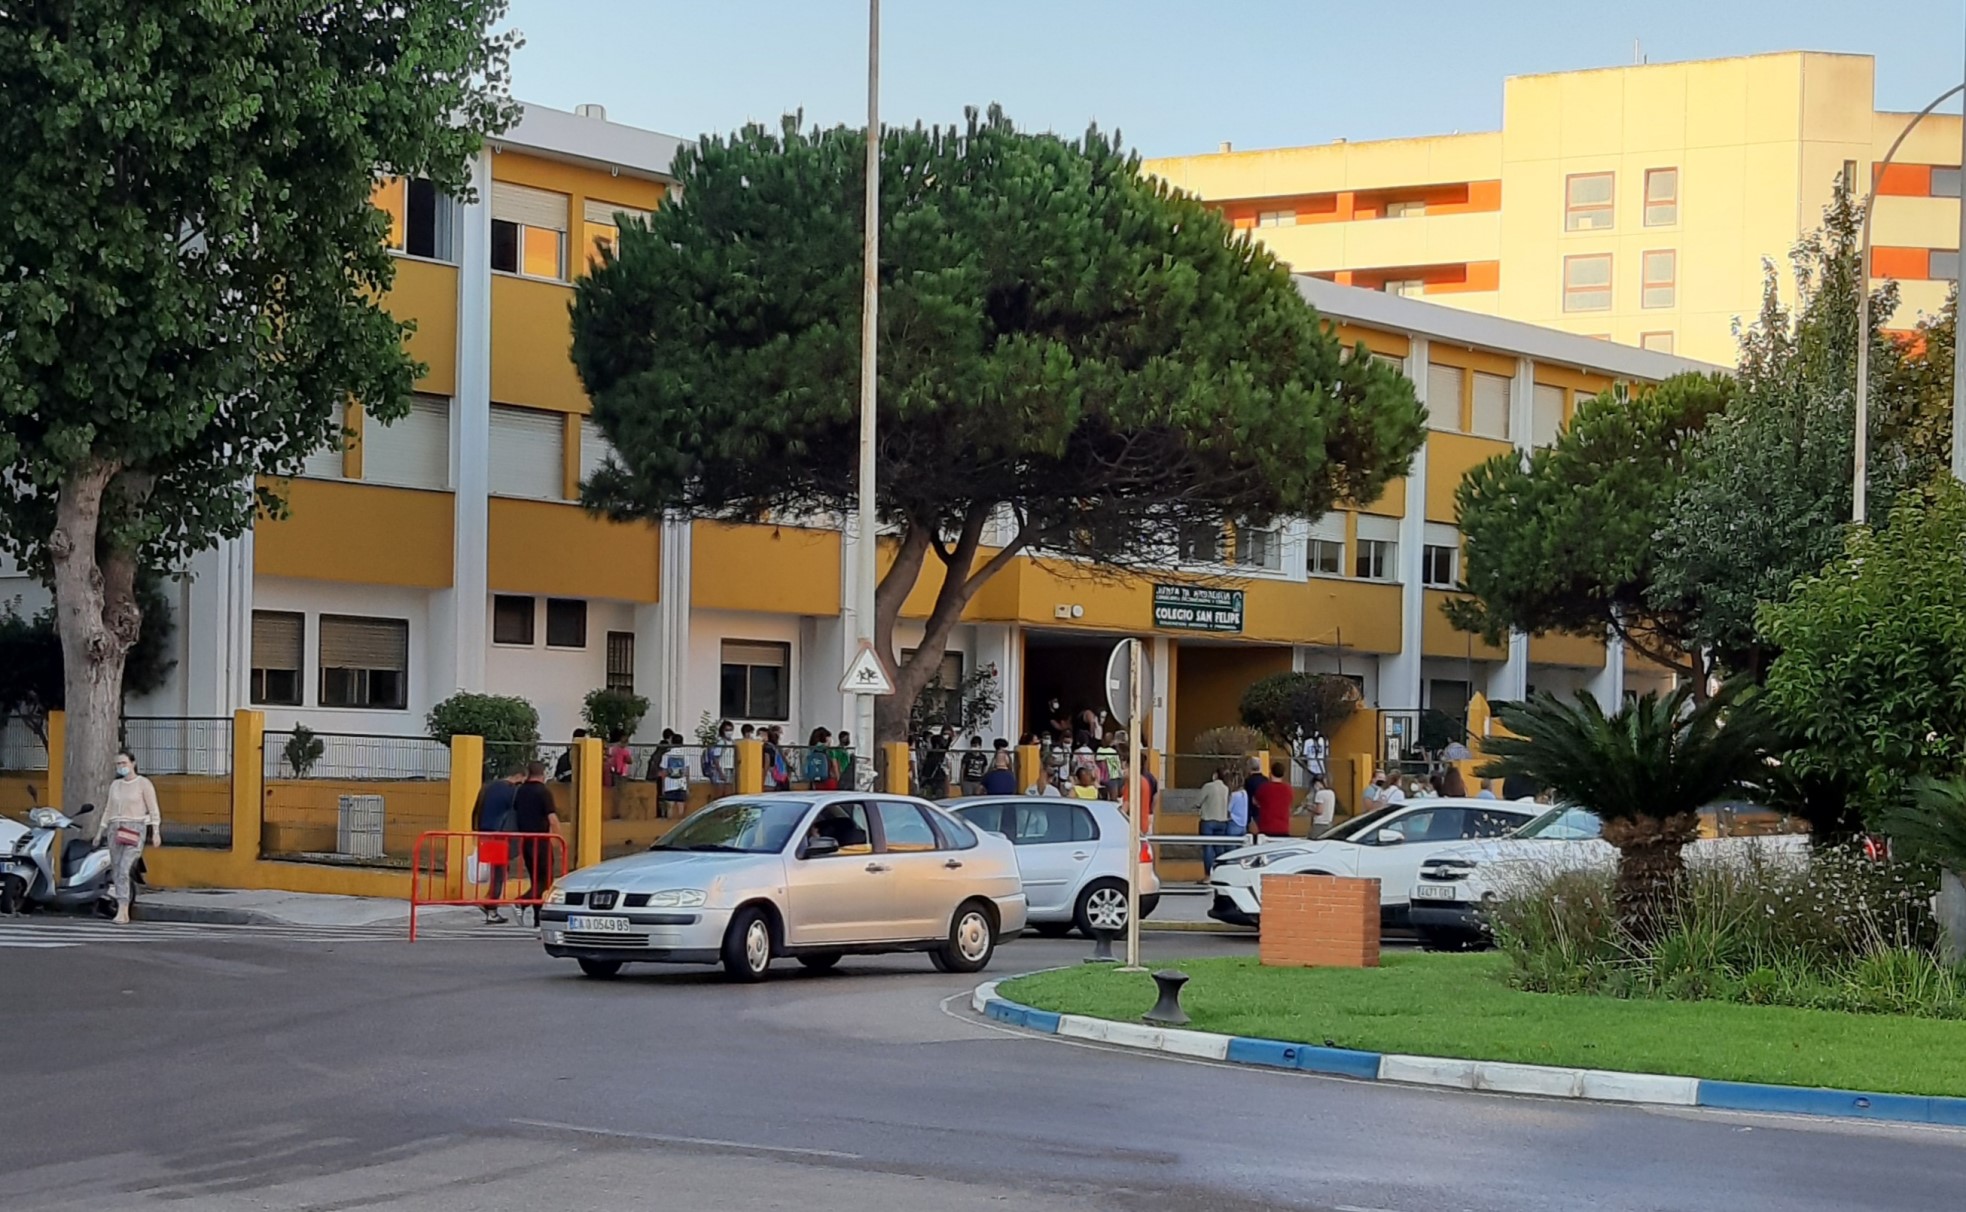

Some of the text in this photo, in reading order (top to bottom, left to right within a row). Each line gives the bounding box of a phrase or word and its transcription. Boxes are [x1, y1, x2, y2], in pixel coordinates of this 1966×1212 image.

[1156, 608, 1240, 624] COLEGIO SAN FELIPE
